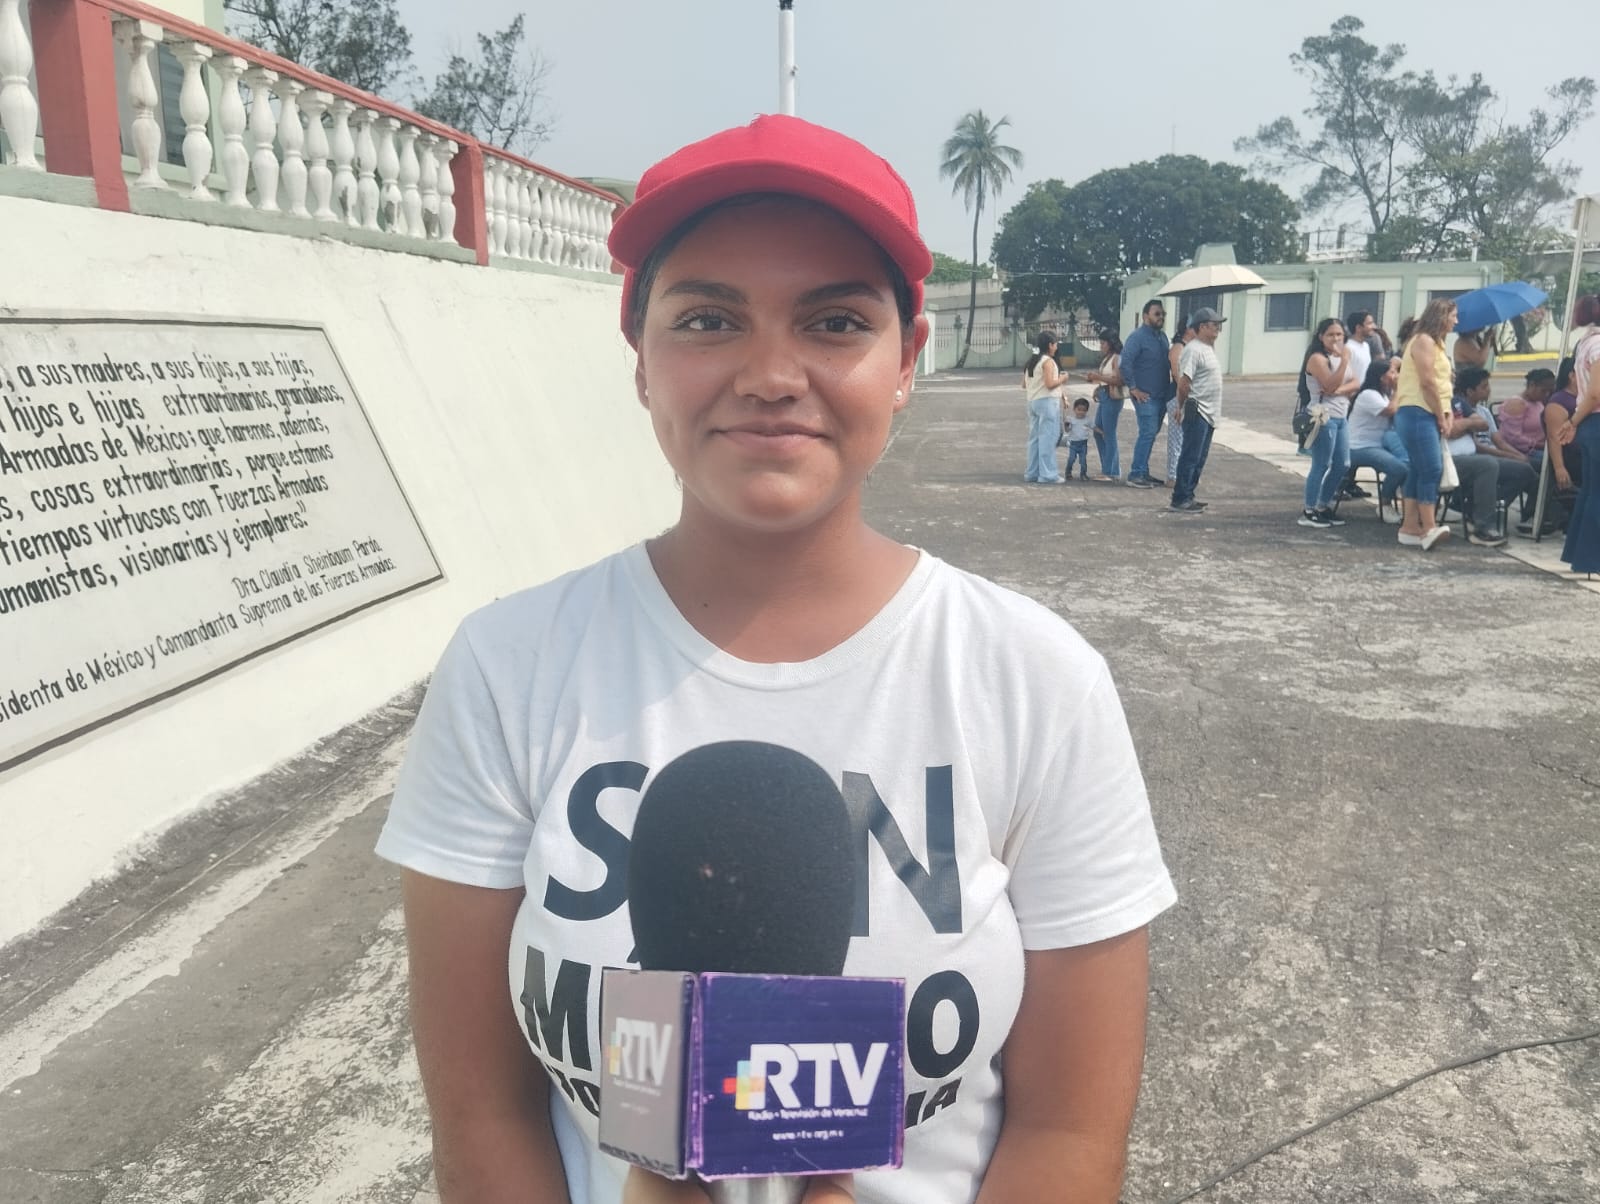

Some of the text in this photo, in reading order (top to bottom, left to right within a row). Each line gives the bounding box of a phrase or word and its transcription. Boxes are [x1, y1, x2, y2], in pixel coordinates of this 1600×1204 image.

[17, 365, 36, 387] a
[36, 364, 73, 386] sus
[71, 352, 153, 384] madres,
[151, 361, 166, 381] a
[165, 360, 195, 379] sus
[192, 351, 241, 384] hijos,
[238, 361, 251, 378] a
[251, 359, 275, 377] sus
[271, 351, 315, 382] hijas,
[0, 432, 99, 475] Armadas
[101, 427, 128, 460] de
[126, 423, 198, 456] México;
[197, 427, 226, 457] que
[219, 416, 283, 443] haremos,
[3, 395, 64, 438] hijos
[68, 402, 85, 425] e
[87, 389, 145, 429] hijas
[30, 481, 95, 513] cosas
[245, 450, 290, 480] porque
[288, 439, 334, 467] estamos
[0, 469, 329, 566] tiempos virtuosos con Fuerzas Armadas
[119, 530, 218, 577] visionarias
[217, 529, 232, 559] y
[231, 576, 262, 599] Dra.
[259, 561, 302, 591] Claudia
[303, 546, 355, 575] Sheinbaum
[65, 668, 88, 693] de
[85, 650, 145, 684] México
[143, 643, 157, 670] y
[156, 611, 239, 657] Comandanta
[238, 593, 292, 628] Suprema
[292, 584, 308, 603] de
[308, 580, 324, 600] las
[319, 569, 360, 593] Fuerzas
[543, 760, 963, 937] SN
[613, 1016, 673, 1088] RTV
[748, 1042, 889, 1110] RTV
